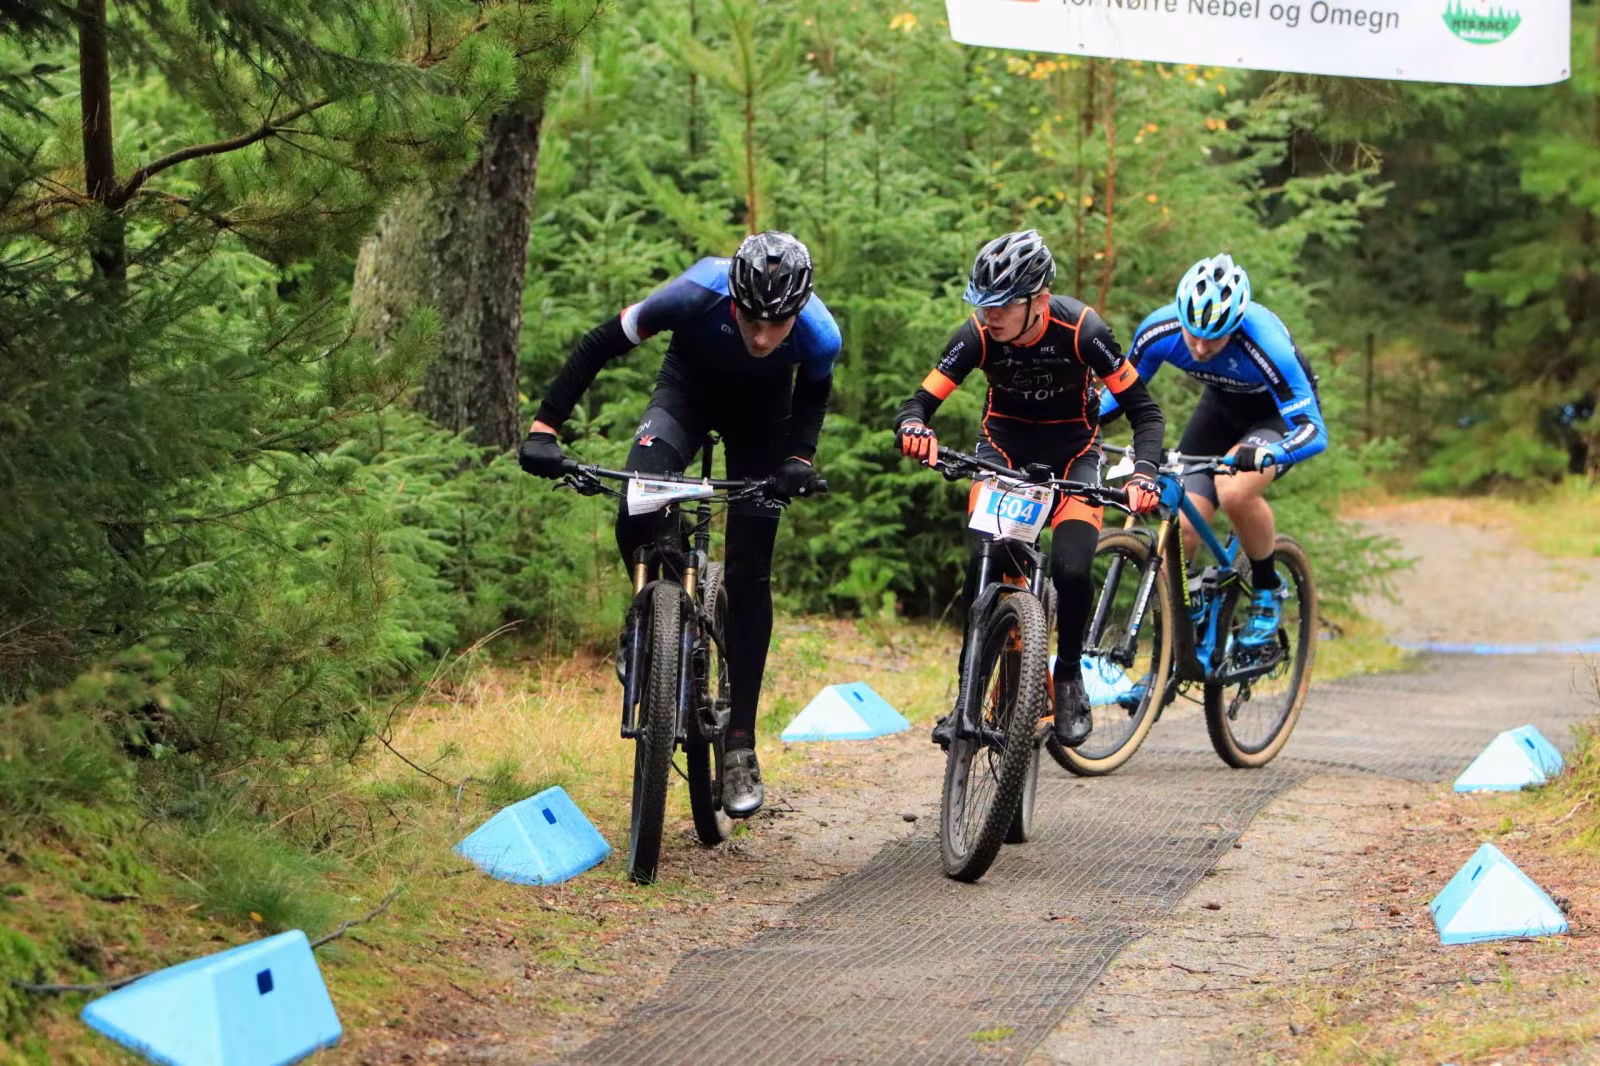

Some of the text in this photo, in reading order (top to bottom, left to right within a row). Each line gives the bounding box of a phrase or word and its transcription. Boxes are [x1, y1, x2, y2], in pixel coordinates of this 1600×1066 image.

[1188, 0, 1260, 19] Nebel
[1269, 4, 1301, 28] og
[1310, 1, 1400, 34] Omegn
[905, 427, 931, 436] FOX
[1140, 481, 1162, 494] FOX
[994, 497, 1035, 522] 504
